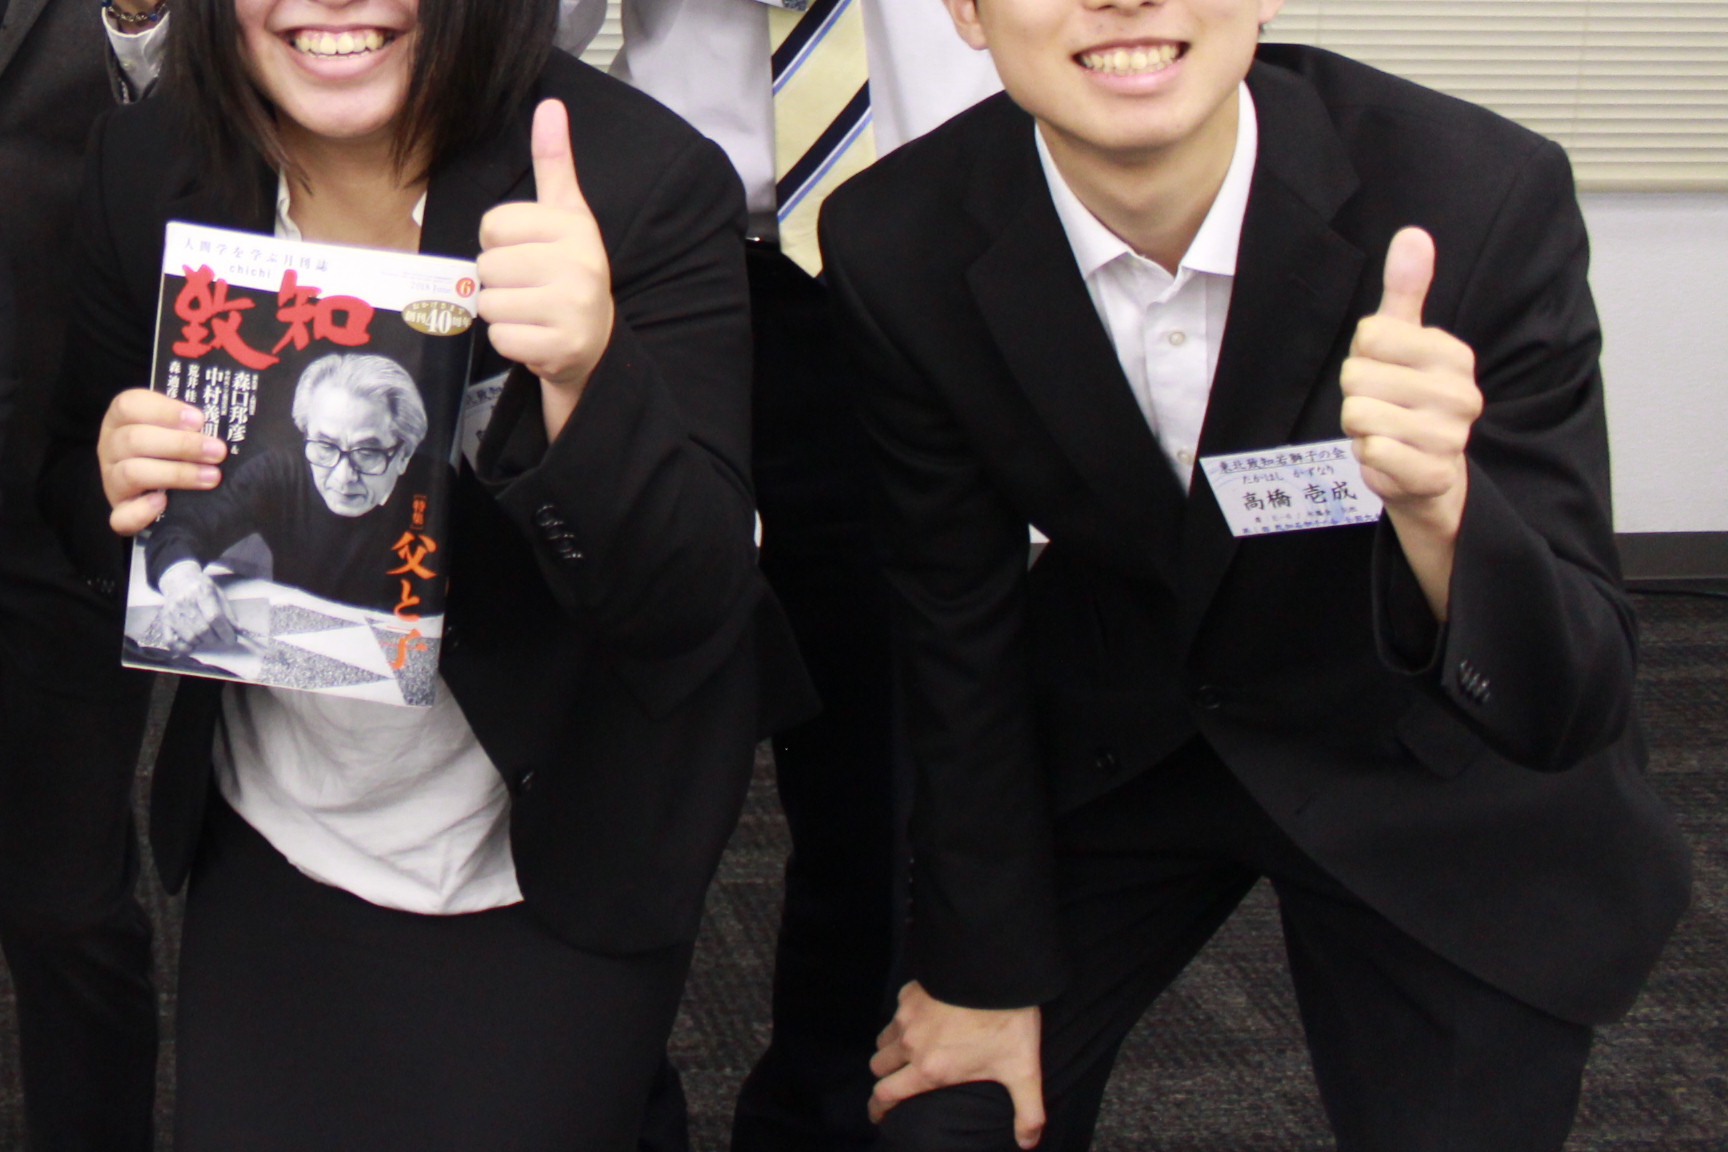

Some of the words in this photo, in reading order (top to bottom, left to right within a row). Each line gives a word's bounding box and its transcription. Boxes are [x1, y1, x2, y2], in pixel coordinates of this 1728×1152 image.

[184, 238, 328, 272] 人間学を学ぶ月刊誌
[229, 263, 271, 279] chichi
[460, 280, 472, 297] 6
[172, 264, 375, 369] 致知
[202, 366, 224, 439] 中村義明
[227, 371, 251, 442] 森口邦彦
[1219, 447, 1347, 472] 東北致知若獅子の会
[1243, 471, 1284, 485] たかはし
[1293, 464, 1335, 479] かずなり
[1243, 488, 1292, 511] 高橋
[1303, 480, 1358, 504] 壱成
[379, 530, 437, 670] 父と子
